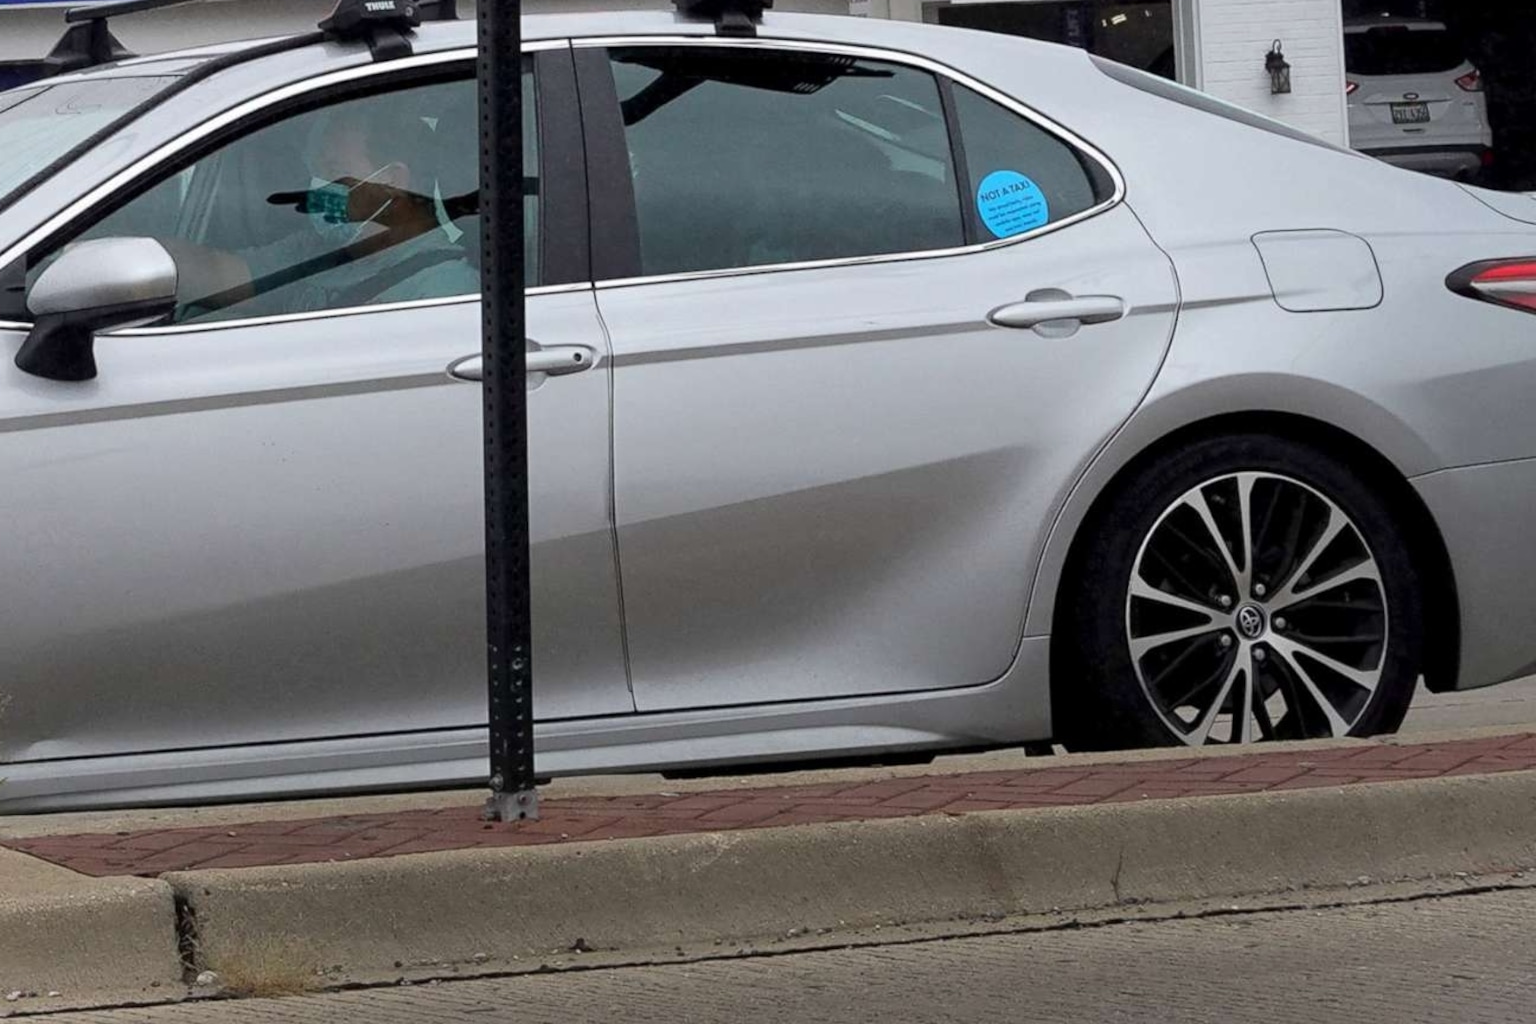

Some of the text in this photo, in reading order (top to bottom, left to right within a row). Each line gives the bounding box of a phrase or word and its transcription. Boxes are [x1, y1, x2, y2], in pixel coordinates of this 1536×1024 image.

[365, 0, 396, 12] THULE
[980, 188, 1002, 203] NOT
[1009, 179, 1031, 193] TAXI
